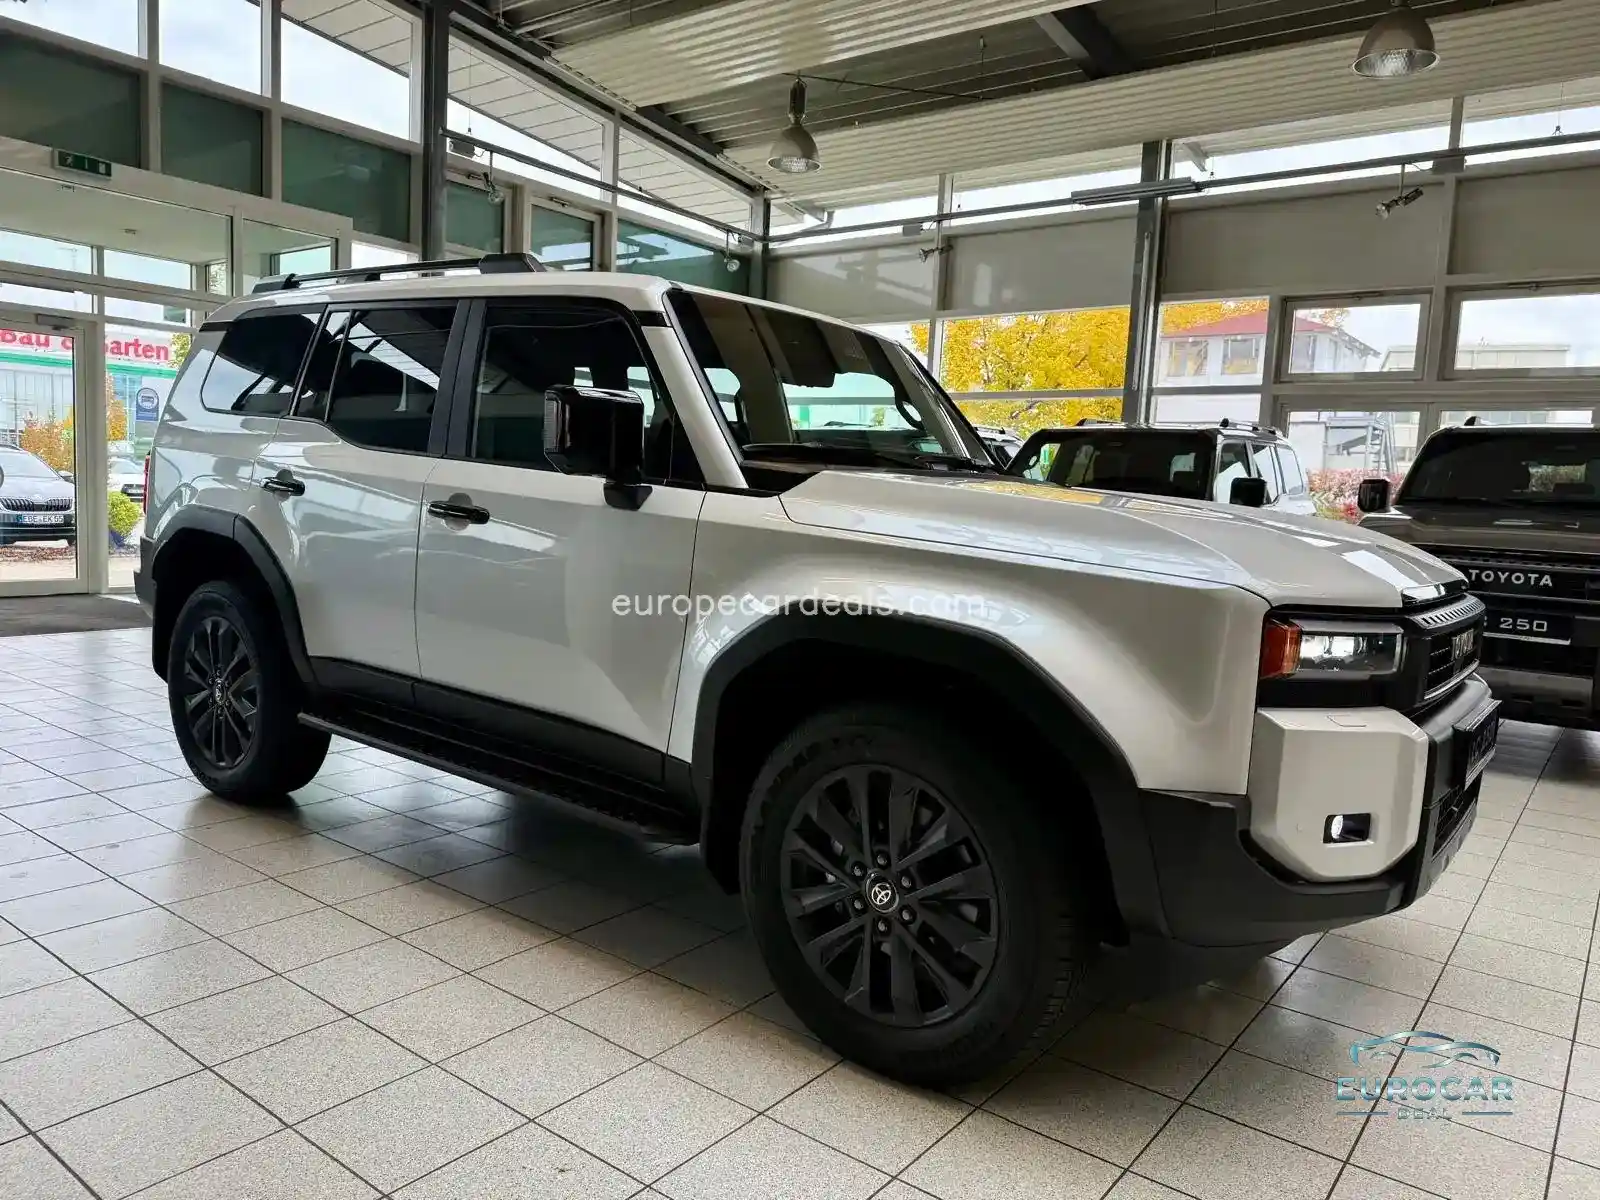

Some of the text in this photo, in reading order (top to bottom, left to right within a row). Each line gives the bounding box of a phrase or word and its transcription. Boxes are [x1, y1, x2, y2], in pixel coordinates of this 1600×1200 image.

[104, 337, 169, 360] arten
[1468, 569, 1553, 587] TOYOTA
[1499, 617, 1548, 632] 250
